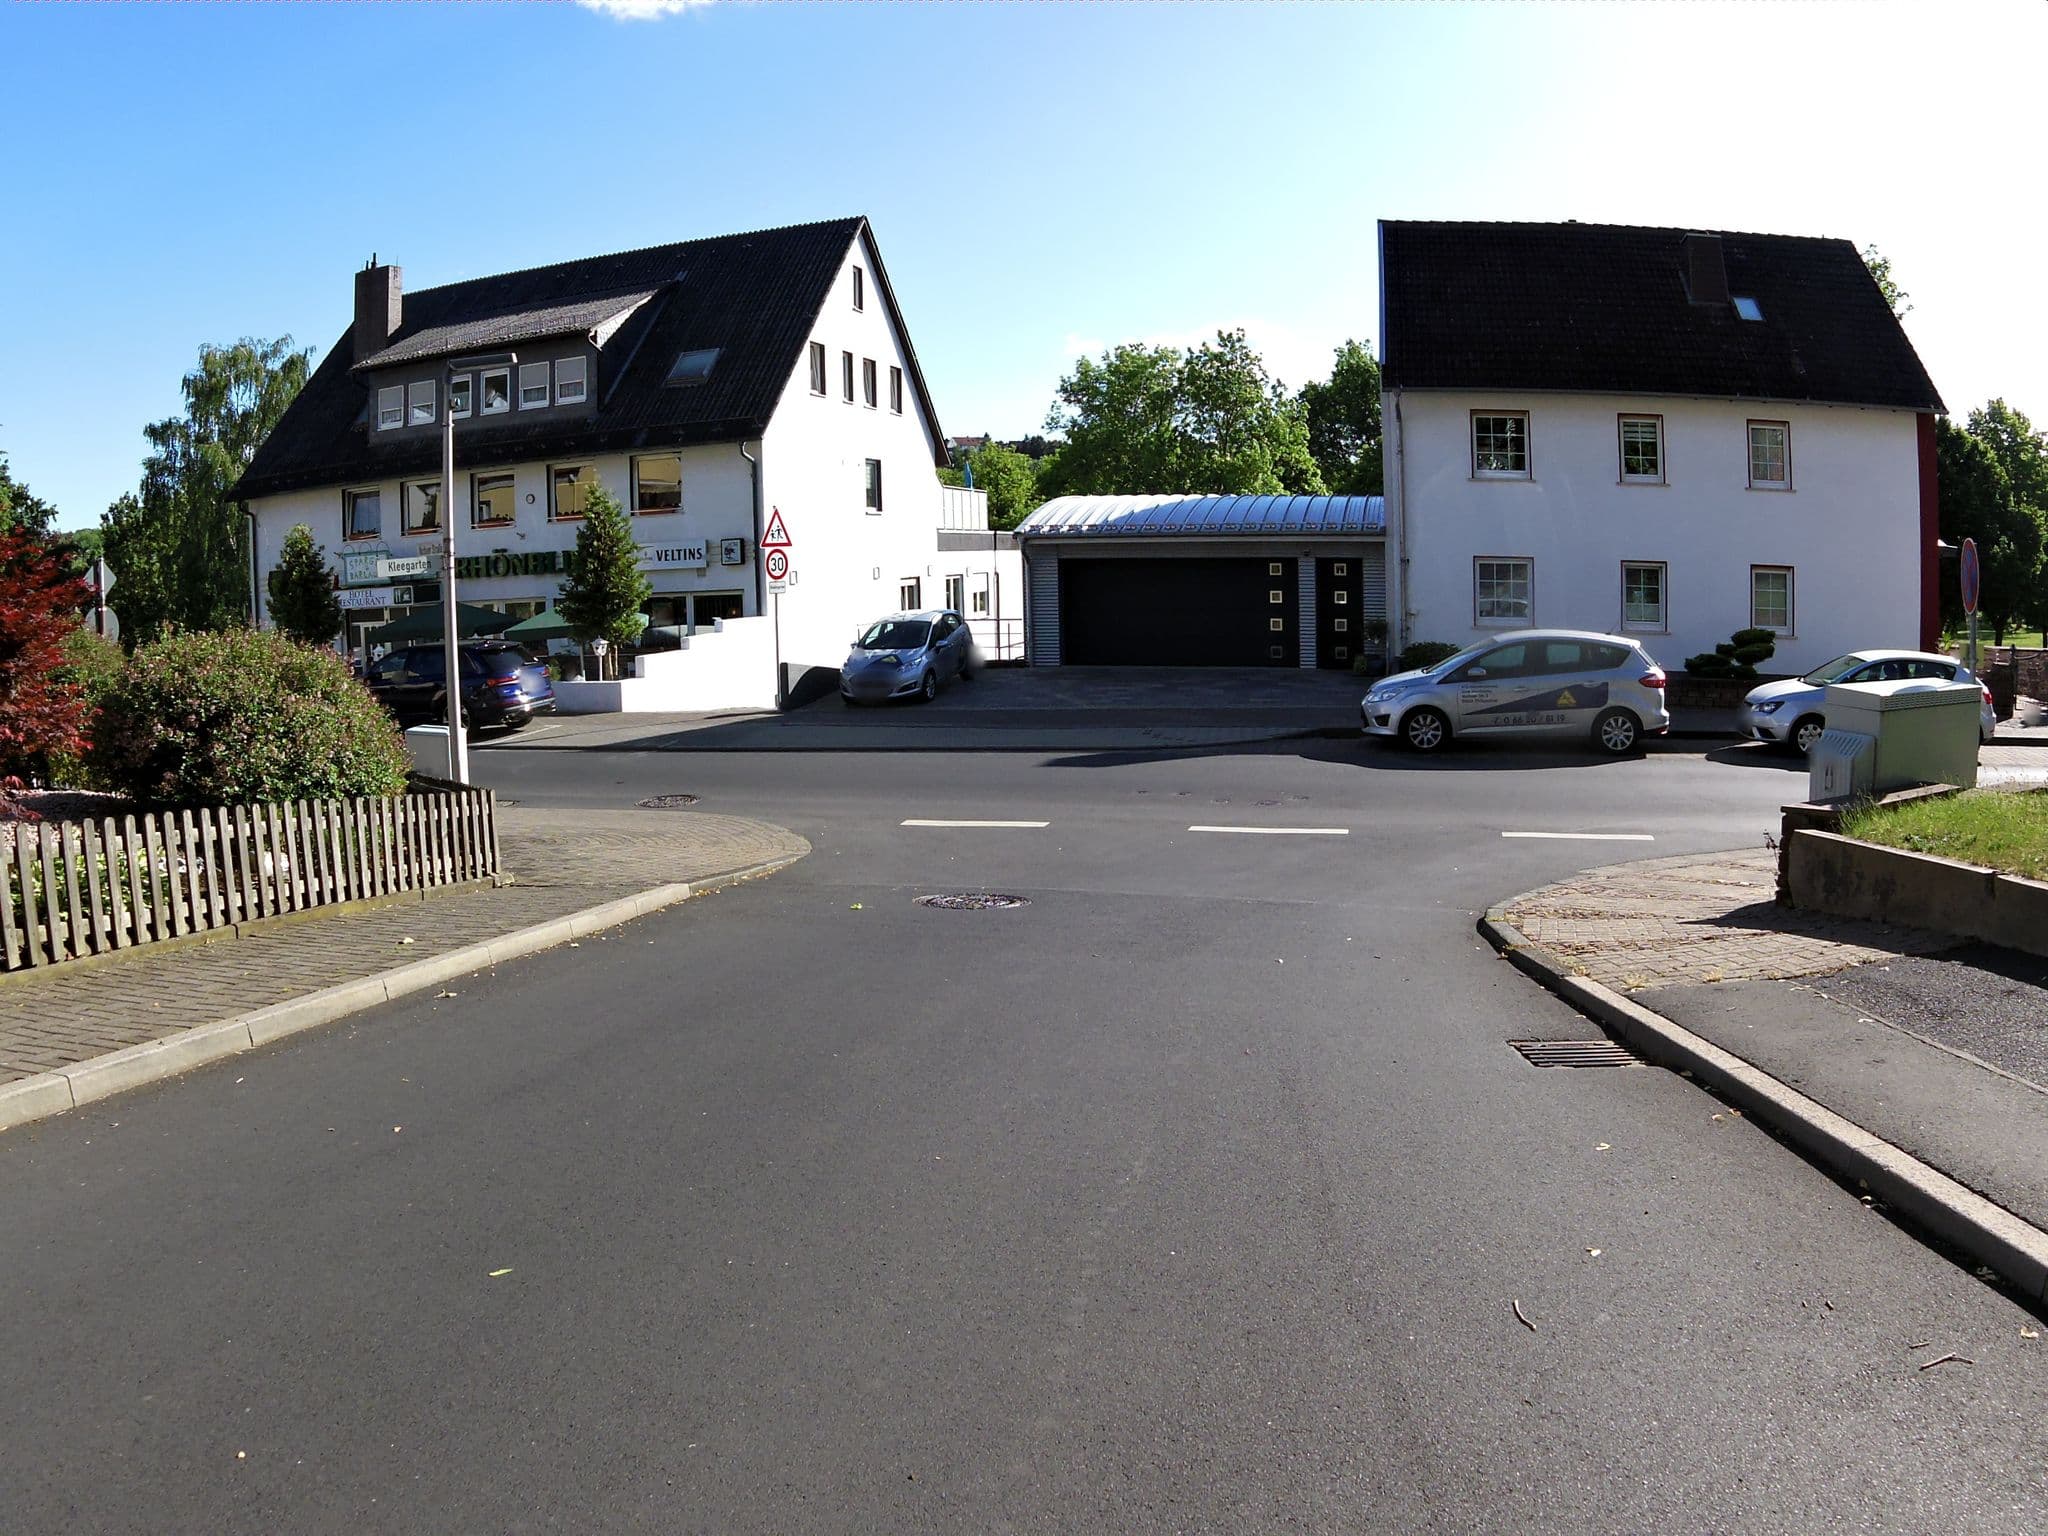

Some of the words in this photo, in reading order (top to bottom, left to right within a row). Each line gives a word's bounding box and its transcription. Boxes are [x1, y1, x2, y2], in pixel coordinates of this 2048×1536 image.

[656, 548, 703, 562] VELTINS
[388, 560, 432, 573] Kleegarten
[771, 557, 784, 572] 30
[349, 590, 373, 599] HOTEL
